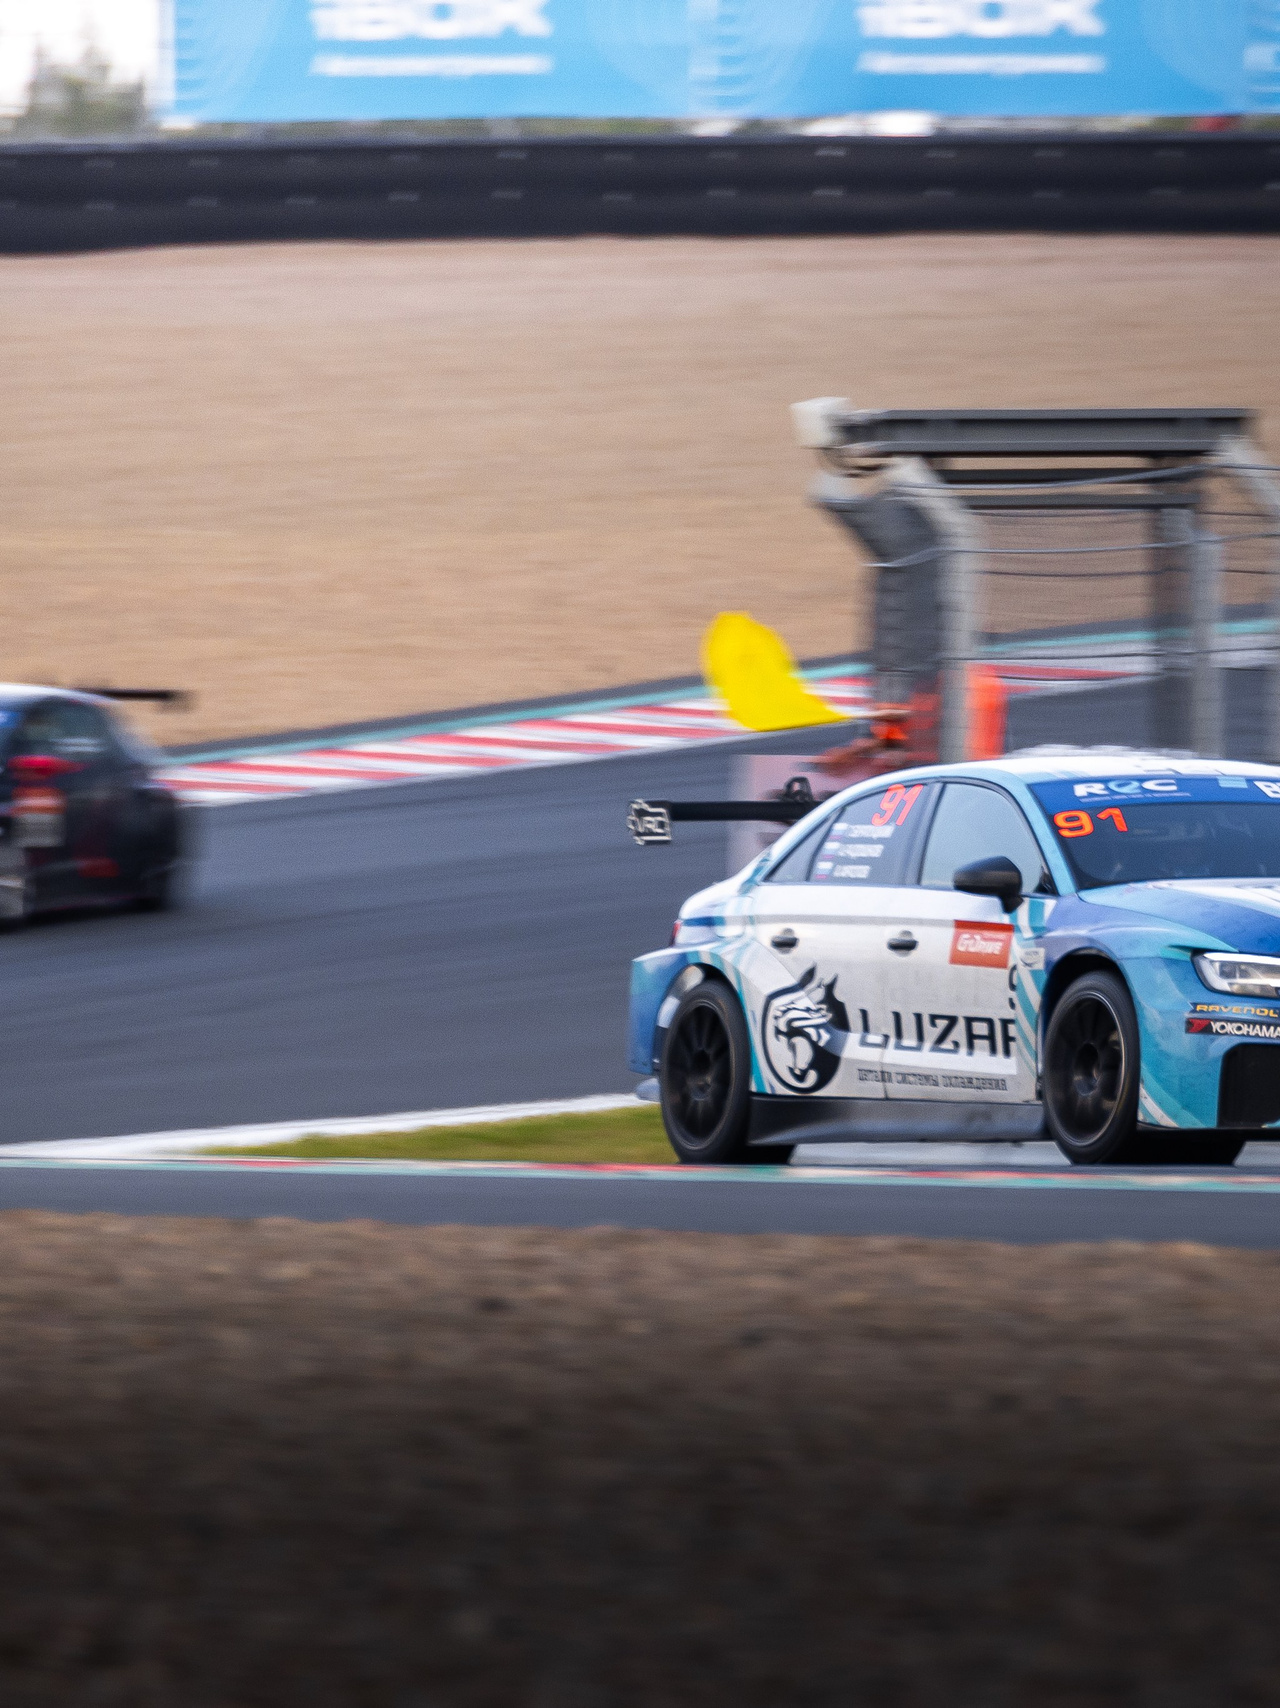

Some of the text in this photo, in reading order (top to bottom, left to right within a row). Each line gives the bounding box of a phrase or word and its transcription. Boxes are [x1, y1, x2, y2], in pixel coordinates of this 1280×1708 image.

[872, 784, 923, 826] 91
[1053, 807, 1129, 838] 91
[1196, 1004, 1279, 1017] RAVENOL
